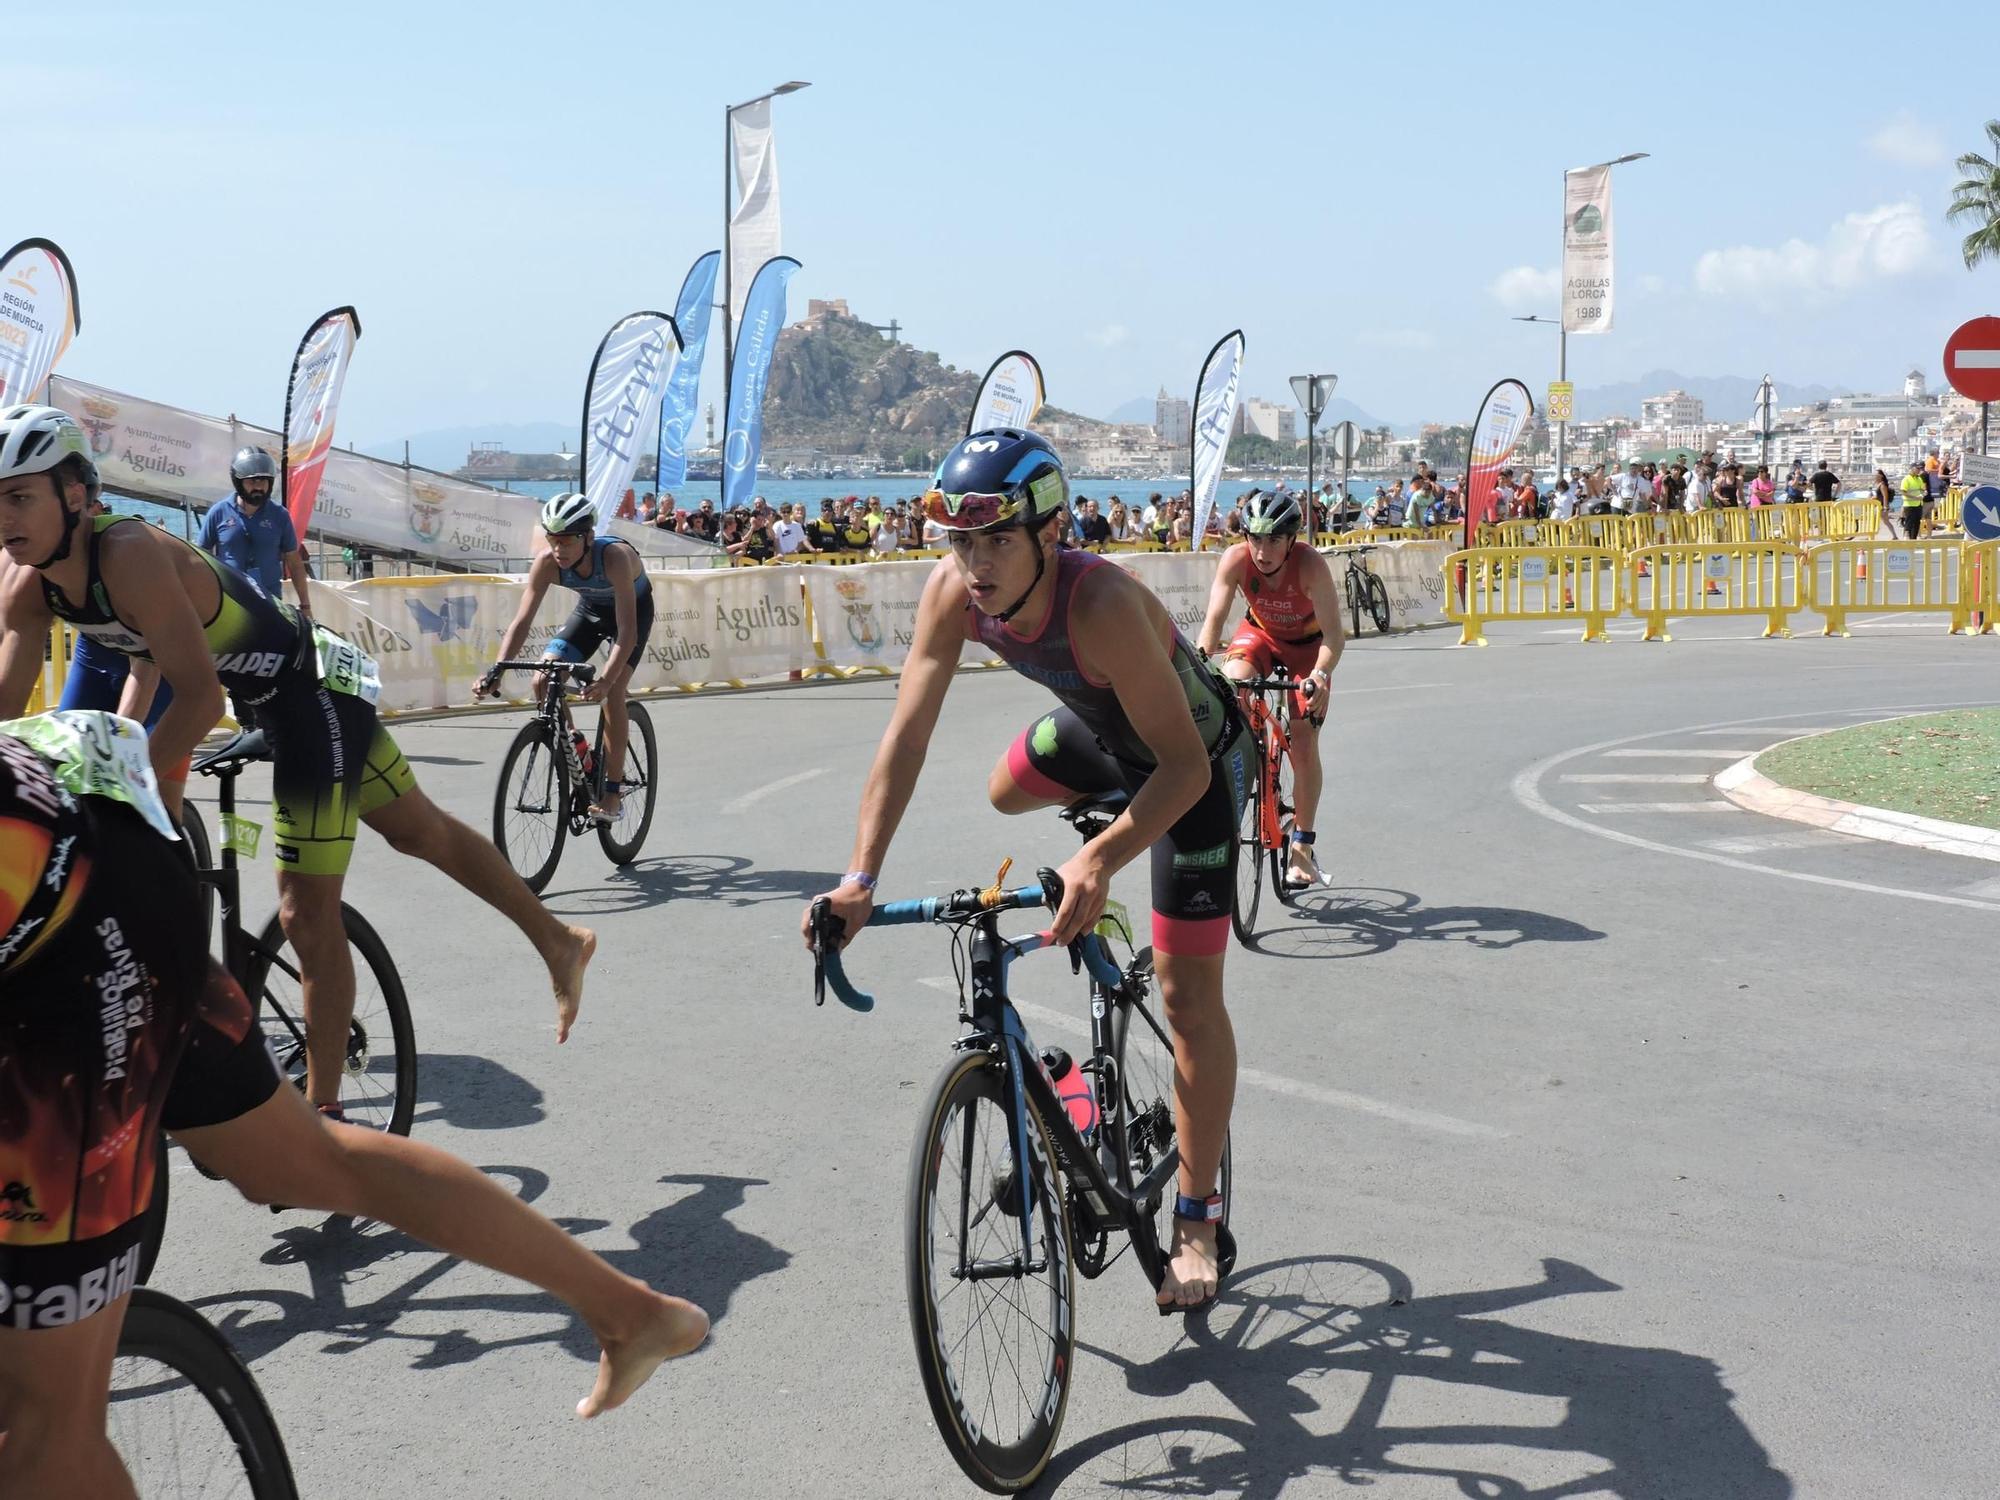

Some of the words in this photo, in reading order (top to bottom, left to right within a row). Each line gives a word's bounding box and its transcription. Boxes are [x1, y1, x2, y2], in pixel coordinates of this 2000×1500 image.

[3, 291, 35, 314] REGIÓN
[1572, 288, 1606, 300] LORCA
[11, 308, 44, 334] MURCIA
[1575, 306, 1602, 319] 1988
[738, 373, 756, 424] Costa
[124, 425, 192, 450] Ayuntamiento
[120, 445, 187, 477] Águilas
[449, 527, 508, 554] Águilas
[715, 594, 801, 642] Águilas
[334, 646, 355, 688] 4210
